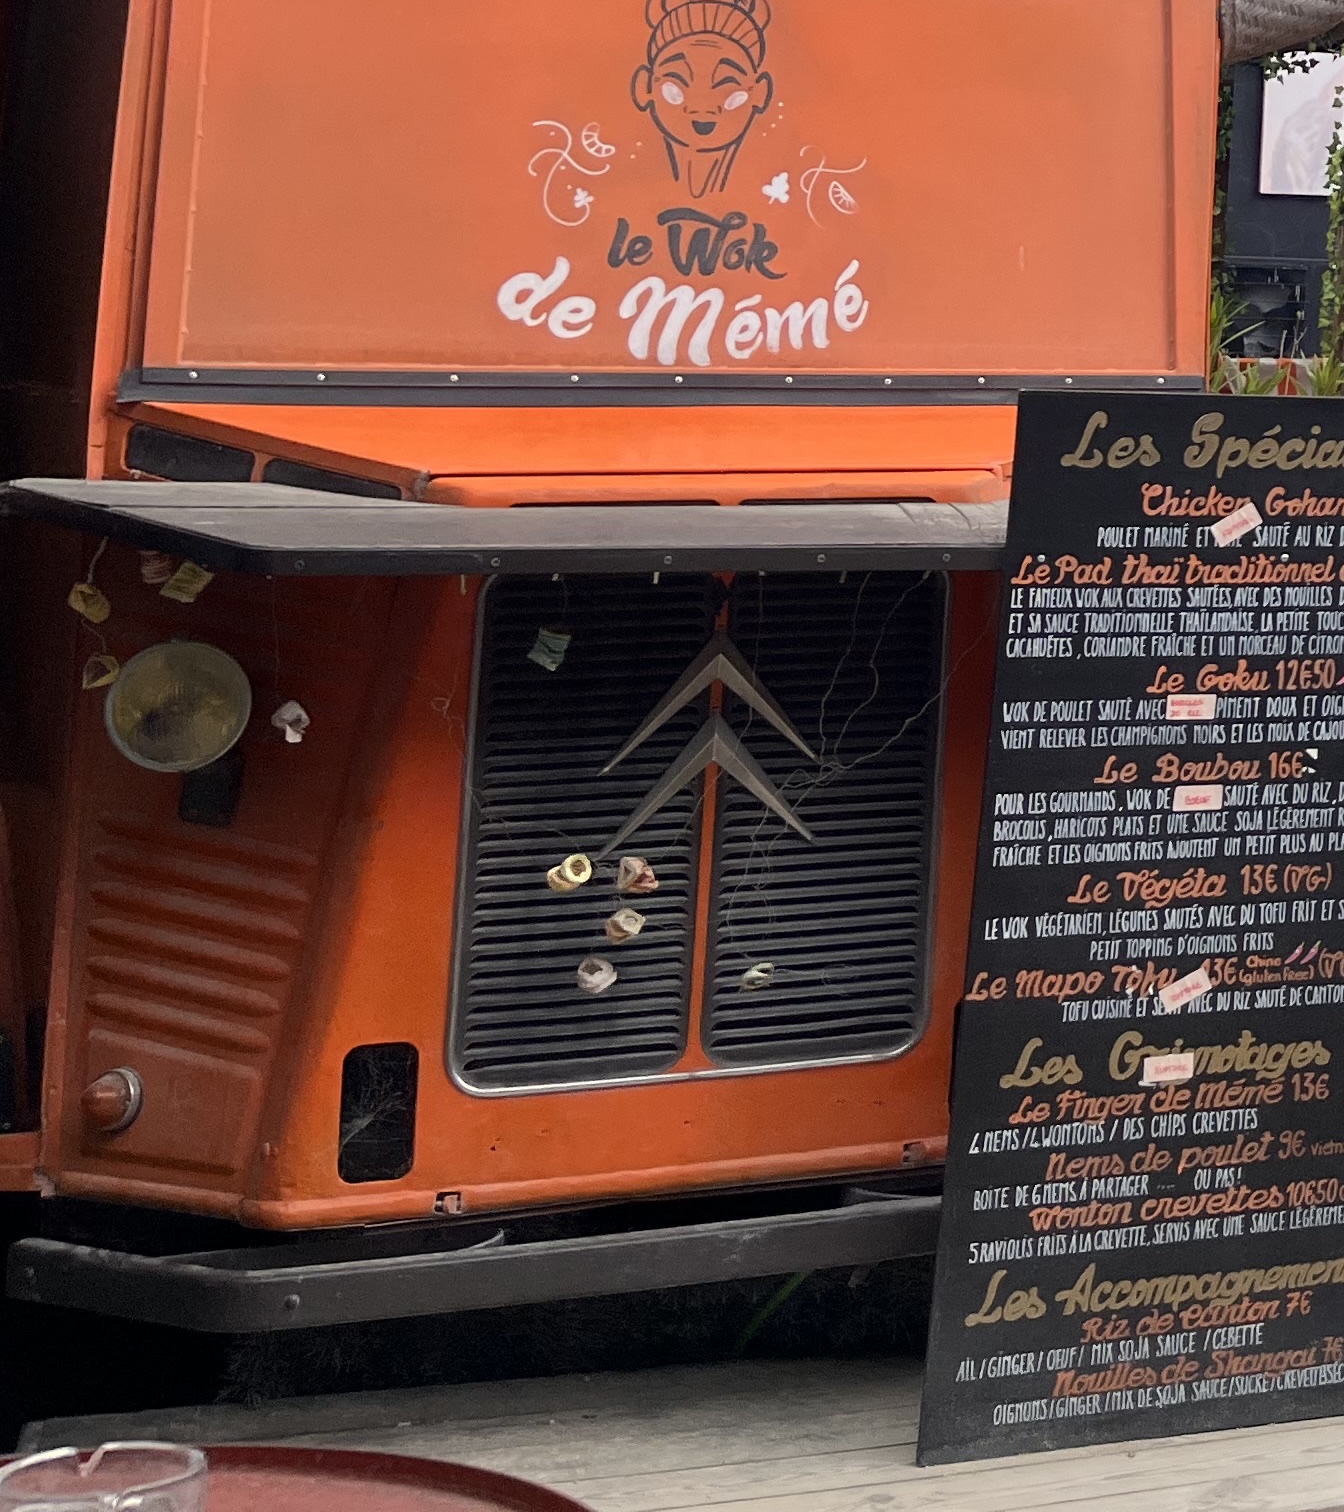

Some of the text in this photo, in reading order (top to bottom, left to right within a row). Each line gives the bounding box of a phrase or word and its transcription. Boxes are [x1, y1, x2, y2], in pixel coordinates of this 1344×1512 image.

[607, 207, 788, 279] le Wok
[496, 255, 869, 366] de Mémé
[1060, 410, 1161, 469] Les
[1097, 525, 1140, 548] POULET
[1144, 522, 1189, 548] MARINÉ
[1252, 522, 1291, 548] SAUTÉ
[1011, 554, 1050, 585] Le
[1054, 554, 1113, 585] Pad
[1122, 553, 1184, 585] thaï
[1184, 553, 1336, 585] traditionnel
[1029, 587, 1073, 609] FAMEUX
[1126, 586, 1182, 608] CREVETTES
[1284, 583, 1333, 607] NOUILLES
[1044, 613, 1080, 634] SAUCE
[1084, 609, 1174, 634] TRADITIONNELLE
[1276, 609, 1310, 631] PETITE
[1083, 634, 1146, 657] CORIANDRE
[1238, 634, 1287, 656] MORCEAU
[1146, 658, 1336, 694] Le Goku 12€50
[1002, 700, 1032, 723] WOK
[1050, 700, 1093, 722] POULET
[1135, 699, 1167, 721] AVEC
[1216, 696, 1261, 720] PIMENT
[1266, 696, 1297, 718] DOUX
[1000, 726, 1036, 749] VIENT
[1039, 727, 1087, 749] RELEVER
[1110, 723, 1187, 747] CHAMPIGNONS
[1192, 722, 1226, 745] NOIRS
[1267, 719, 1294, 742] NOIX
[1093, 751, 1304, 784] Le Boubou 16€
[994, 793, 1025, 816] POUR
[1261, 784, 1288, 806] AVEC
[1053, 814, 1107, 838] HARICOTS
[1112, 815, 1145, 837] PLATS
[1192, 811, 1228, 834] SAUCE
[1234, 809, 1263, 832] SOJA
[1084, 839, 1132, 863] OIGNONS
[1134, 837, 1164, 861] FRITS
[1166, 836, 1219, 860] AJOUTENT
[1245, 834, 1275, 856] PETIT
[1279, 832, 1306, 854] PLUS
[1066, 874, 1111, 904] Le
[1116, 867, 1228, 909] Végéta
[1240, 863, 1278, 895] 13€
[1002, 916, 1029, 939] WOK
[1109, 908, 1159, 935] LÉGUMES
[1164, 903, 1204, 930] SAUTÉS
[1207, 905, 1236, 928] AVEC
[1259, 901, 1286, 925] TOFU
[1291, 898, 1315, 923] FRIT
[1089, 929, 1274, 961] PETIT TOPPING FRITS
[964, 971, 1007, 1001] Le
[1015, 969, 1105, 1004] Mapo
[1062, 1000, 1088, 1023] TOFU
[1000, 1037, 1083, 1088] Les
[1009, 1072, 1330, 1125] Le Finger de Mémé 13€
[982, 1107, 1258, 1153] NEMS DES CHIPS CREVETTES
[1045, 1130, 1306, 1181] Nems de poulet 9€
[1042, 1174, 1149, 1204] NEMS PARTAGER
[1140, 1184, 1284, 1222] crevettes
[1286, 1178, 1339, 1206] 10€50
[980, 1234, 1034, 1263] RAVIOLIS
[1037, 1233, 1067, 1257] FRITS
[1153, 1218, 1191, 1244] SERVIS
[1193, 1217, 1220, 1240] AVEC
[1222, 1214, 1245, 1237] UNE
[1250, 1211, 1285, 1234] SAUCE
[964, 1269, 1047, 1328] Les
[1080, 1314, 1131, 1344] Riz
[1135, 1308, 1174, 1337] de
[1286, 1290, 1314, 1317] 7€
[1090, 1332, 1197, 1366] MIX SOJA SAUCE
[1053, 1363, 1157, 1397] Nouilles
[1161, 1355, 1199, 1384] de
